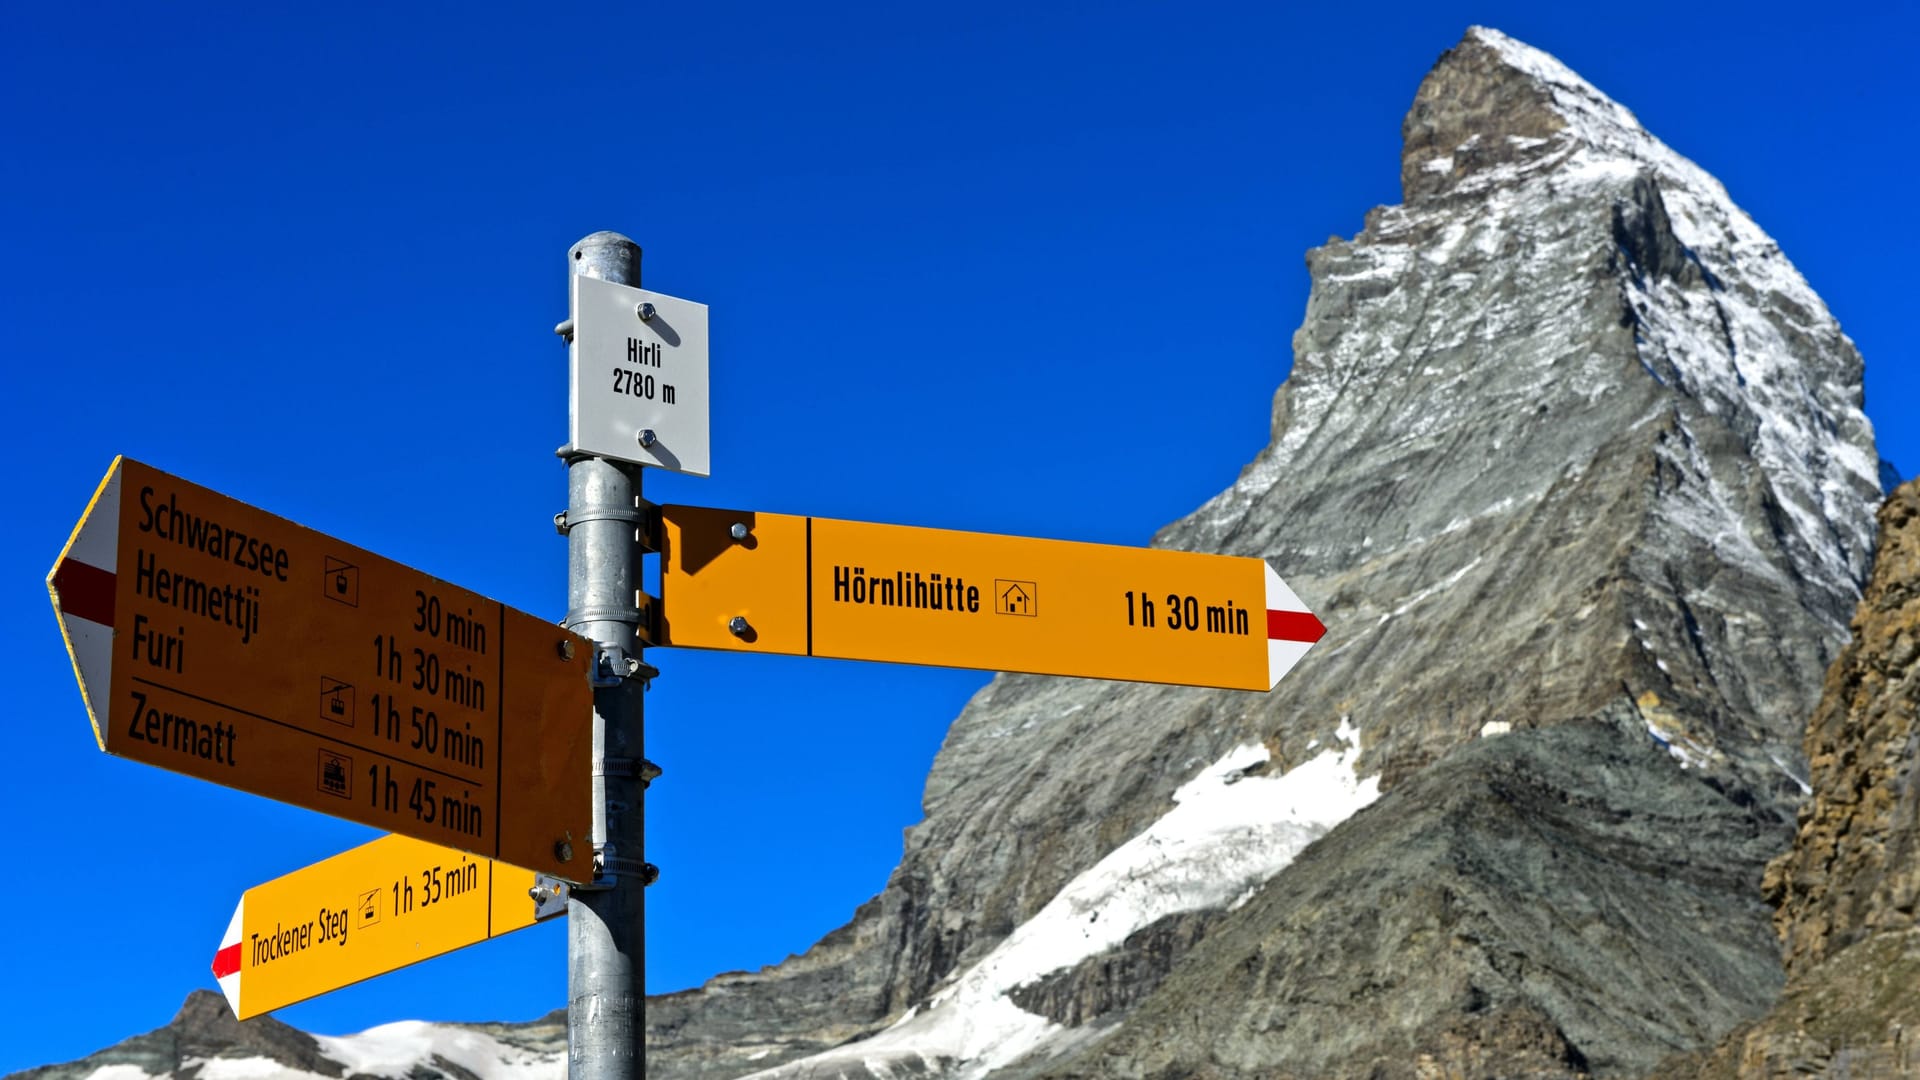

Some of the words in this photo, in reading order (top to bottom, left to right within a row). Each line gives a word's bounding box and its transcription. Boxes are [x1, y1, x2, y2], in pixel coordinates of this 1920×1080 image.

[627, 336, 661, 369] Hirli
[613, 367, 655, 400] 2780
[662, 383, 676, 405] m
[138, 485, 289, 583] Schwarzsee
[135, 548, 260, 645] Hermettji
[834, 565, 980, 613] Hörnlihütte
[1166, 593, 1199, 632] 30
[1206, 599, 1249, 636] min
[132, 613, 185, 674] Furi
[413, 589, 442, 638] 30
[446, 607, 487, 655] min
[412, 647, 440, 696] 30
[445, 664, 485, 712] min
[127, 690, 237, 767] Zermatt
[411, 705, 439, 754] 50
[443, 722, 484, 769] min
[408, 777, 437, 824] 45
[441, 790, 482, 838] min
[421, 866, 441, 908] 35
[445, 854, 478, 899] min
[251, 920, 314, 967] Trockener
[318, 907, 348, 946] Steg
